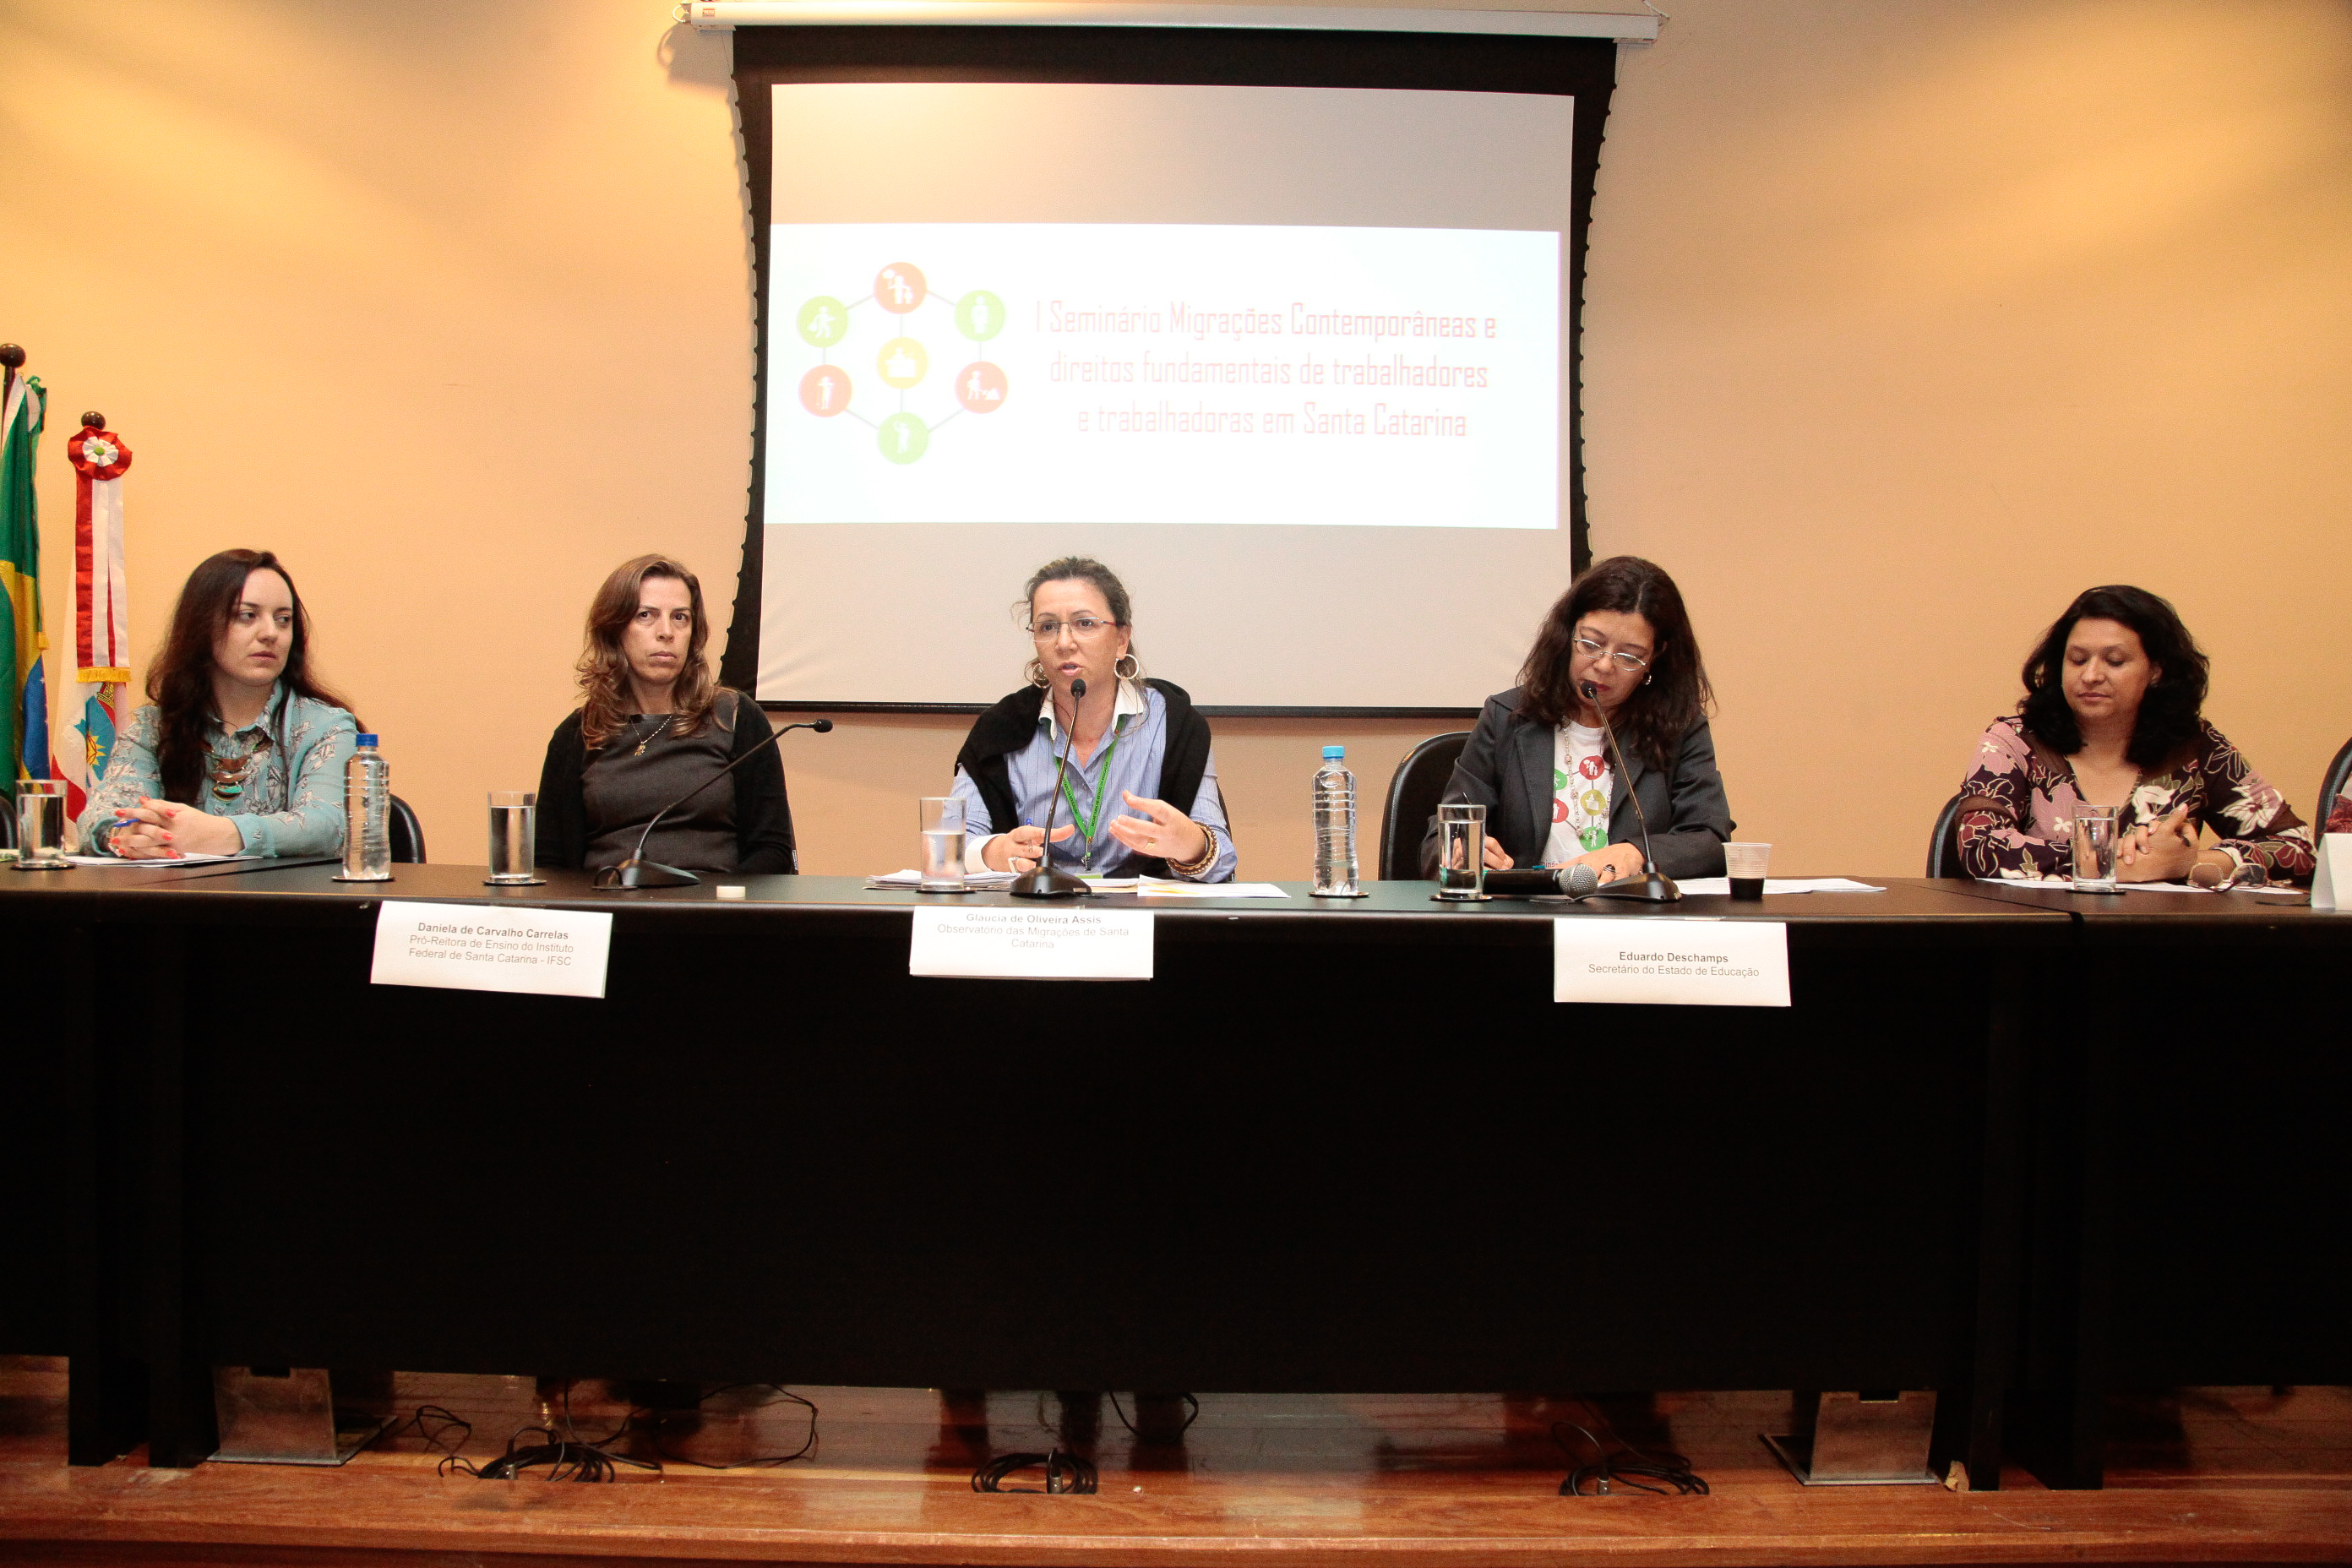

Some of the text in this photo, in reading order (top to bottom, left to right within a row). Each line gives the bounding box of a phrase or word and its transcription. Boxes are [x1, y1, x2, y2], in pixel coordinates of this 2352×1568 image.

[1049, 299, 1161, 334] Seminário
[1169, 301, 1282, 342] Migrações
[1291, 302, 1477, 343] Contemporâneas
[1484, 318, 1496, 339] e
[1050, 350, 1488, 389] direitos fundamentais de trabalhadores
[1078, 400, 1467, 438] e trabalhadoras em Santa Catarina
[966, 913, 1102, 924] Gláucia de Oliveira Assis
[417, 922, 569, 940] Daniela de Carvalho Carrelas
[937, 923, 1130, 939] Observatório das Migrações de Santa
[409, 934, 574, 953] Pró-Reitora de Ensino do Instituto
[1011, 936, 1054, 949] Catarina
[408, 947, 447, 959] Federal
[449, 950, 463, 961] de
[465, 950, 494, 962] Santa
[497, 952, 538, 965] Catarina
[547, 956, 572, 966] IFSC
[1619, 951, 1729, 965] Eduardo Deschamps
[1588, 963, 1760, 979] Secretário do Estado de Educação
